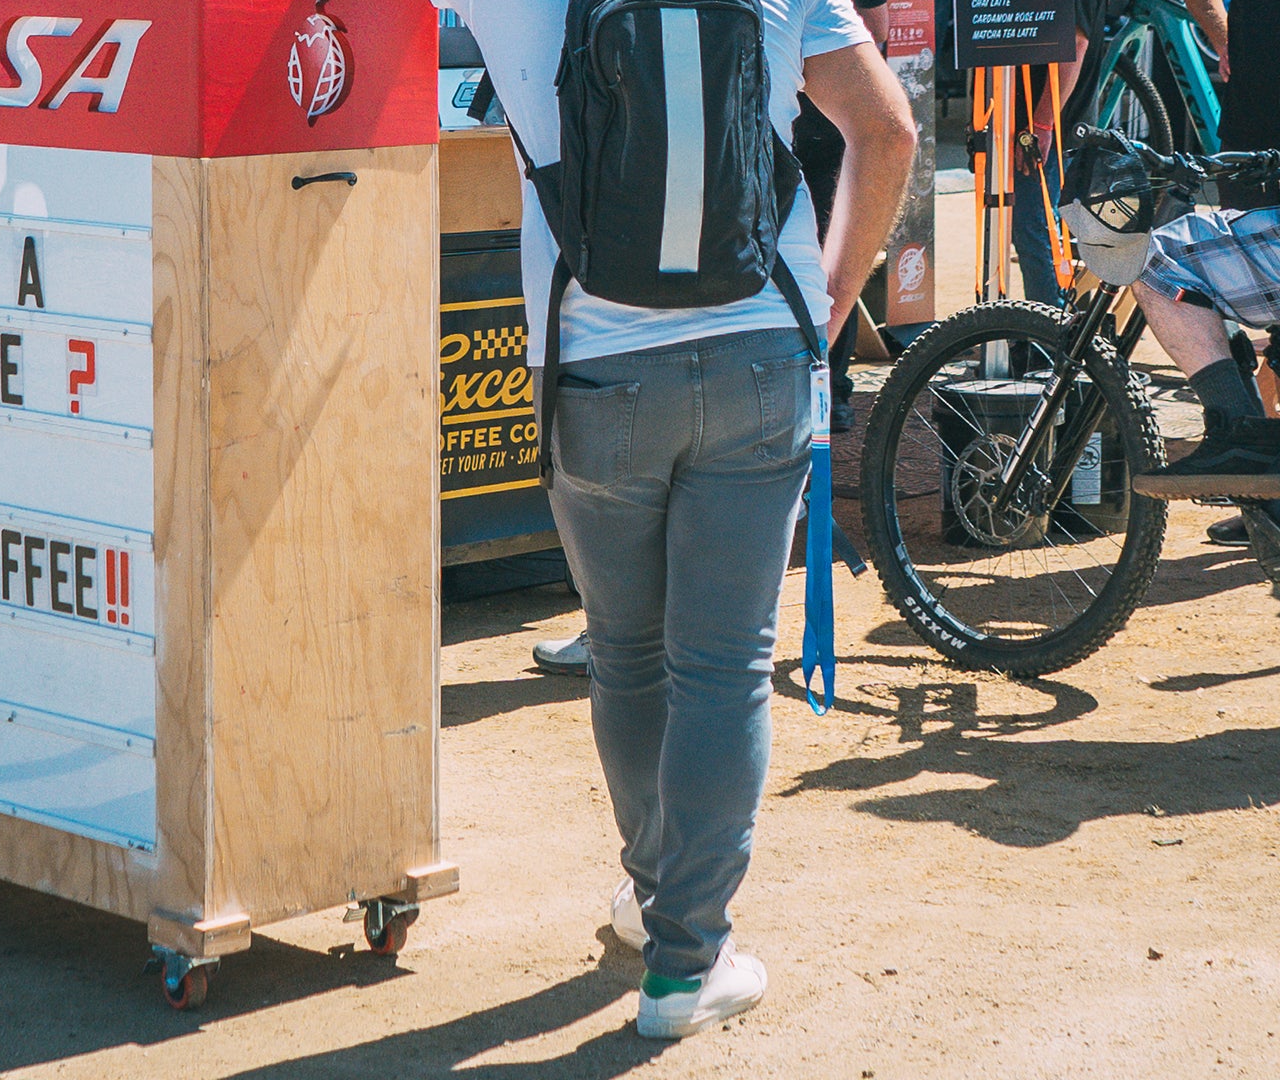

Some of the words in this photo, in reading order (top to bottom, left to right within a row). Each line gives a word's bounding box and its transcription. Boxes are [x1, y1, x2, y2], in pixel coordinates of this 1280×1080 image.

[972, 29, 1001, 40] MATCHA
[1002, 28, 1016, 38] TEA
[1016, 27, 1039, 38] LATTE
[1034, 10, 1056, 21] LATTE
[17, 236, 45, 309] A
[68, 339, 97, 414] ?
[458, 452, 487, 473] YOUR
[489, 450, 508, 469] FIX
[904, 596, 968, 650] MAXXIS
